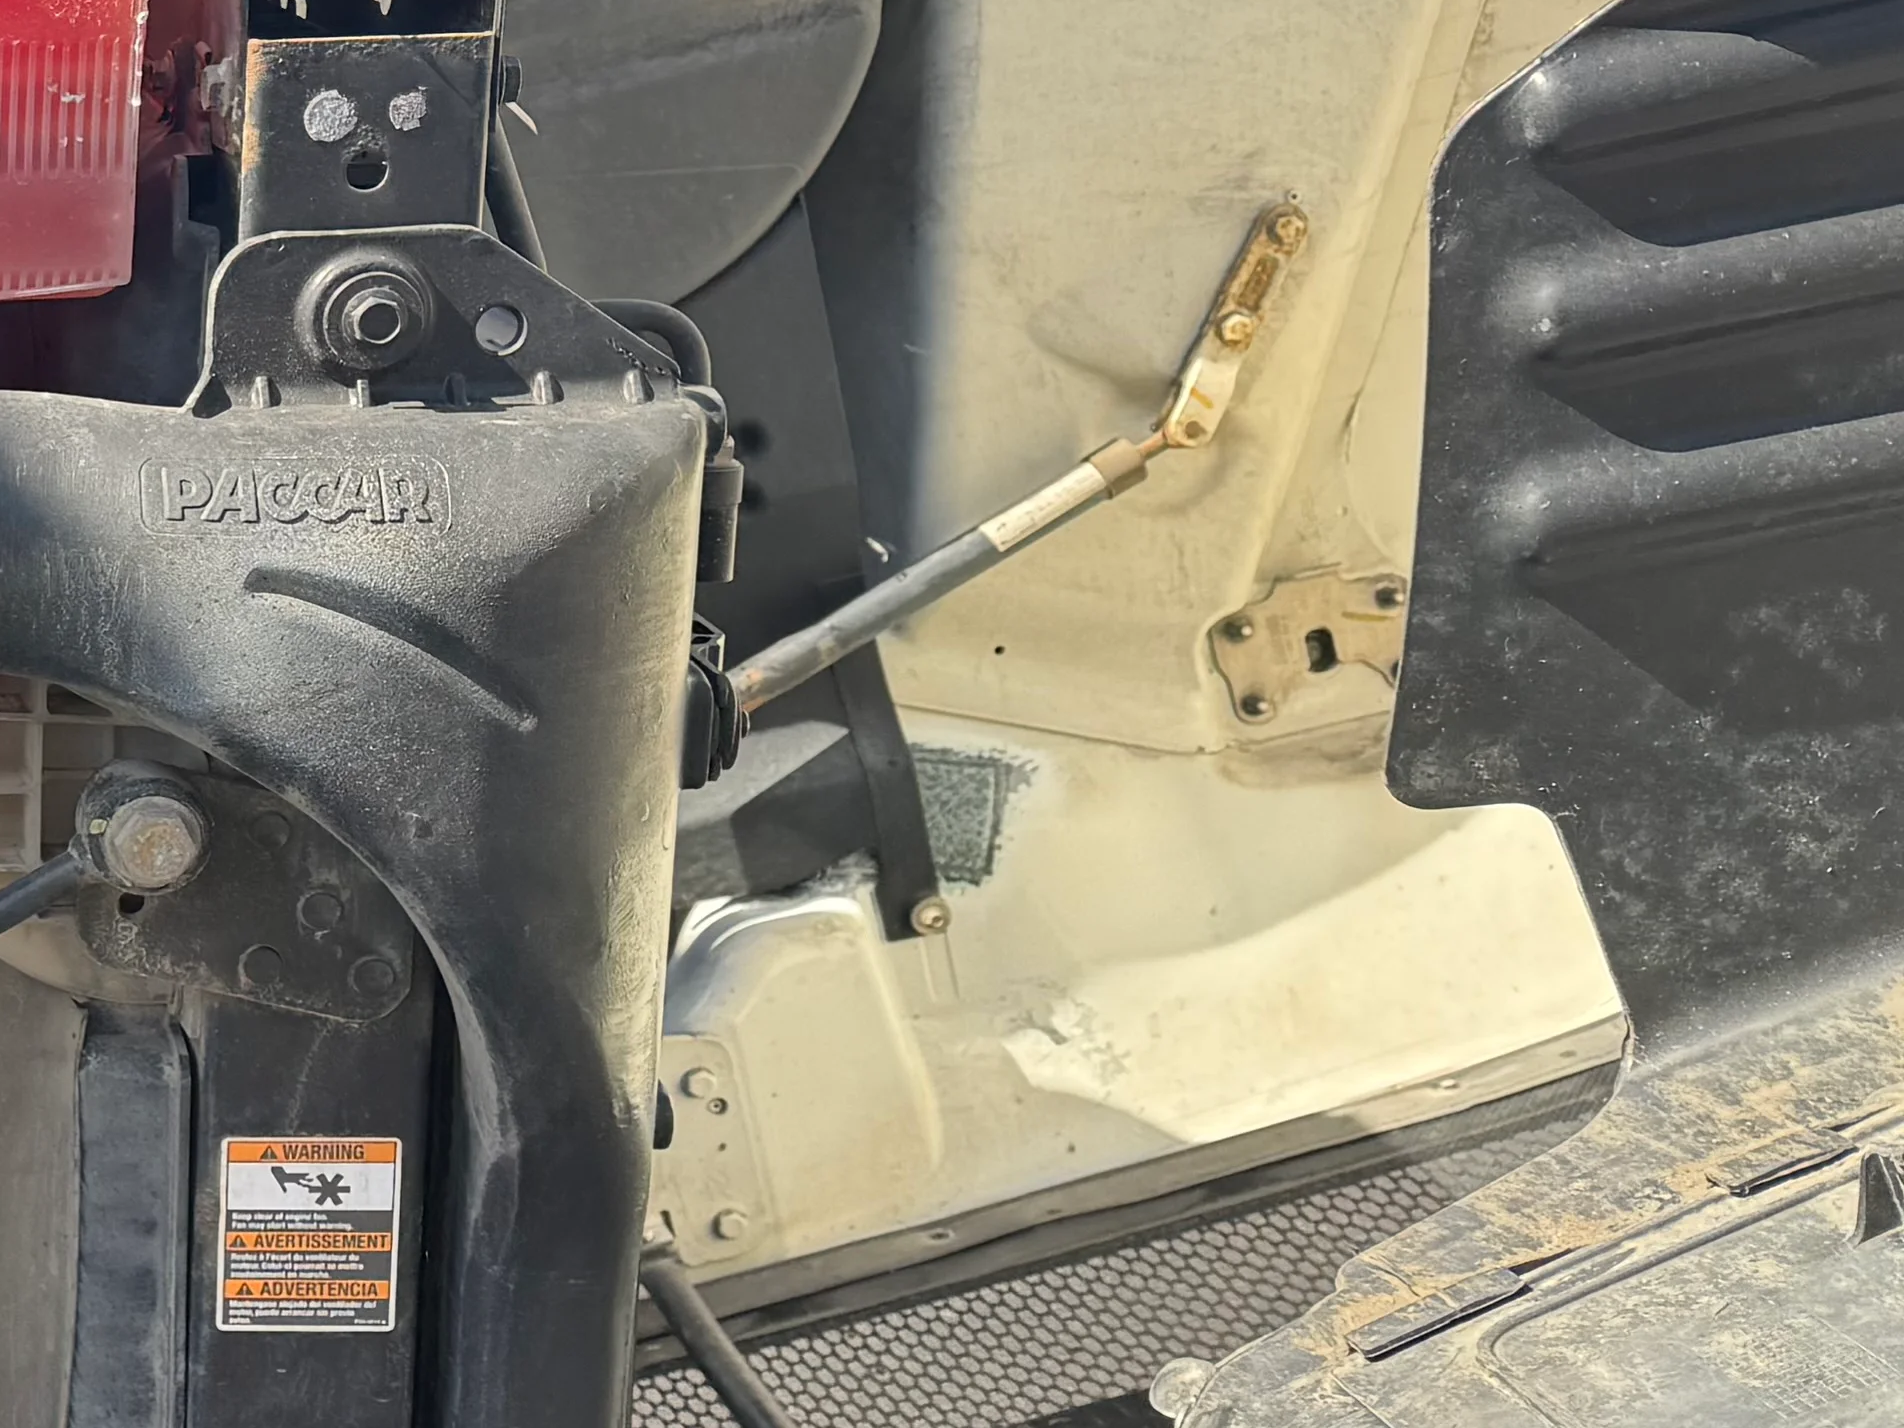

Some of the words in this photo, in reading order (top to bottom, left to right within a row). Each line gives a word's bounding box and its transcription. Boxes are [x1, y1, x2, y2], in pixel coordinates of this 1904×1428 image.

[161, 468, 433, 524] PACCAR
[282, 1144, 365, 1160] WARNING
[253, 1234, 389, 1249] AVERTISSEMENT
[260, 1282, 378, 1297] ADVERTENCIA
